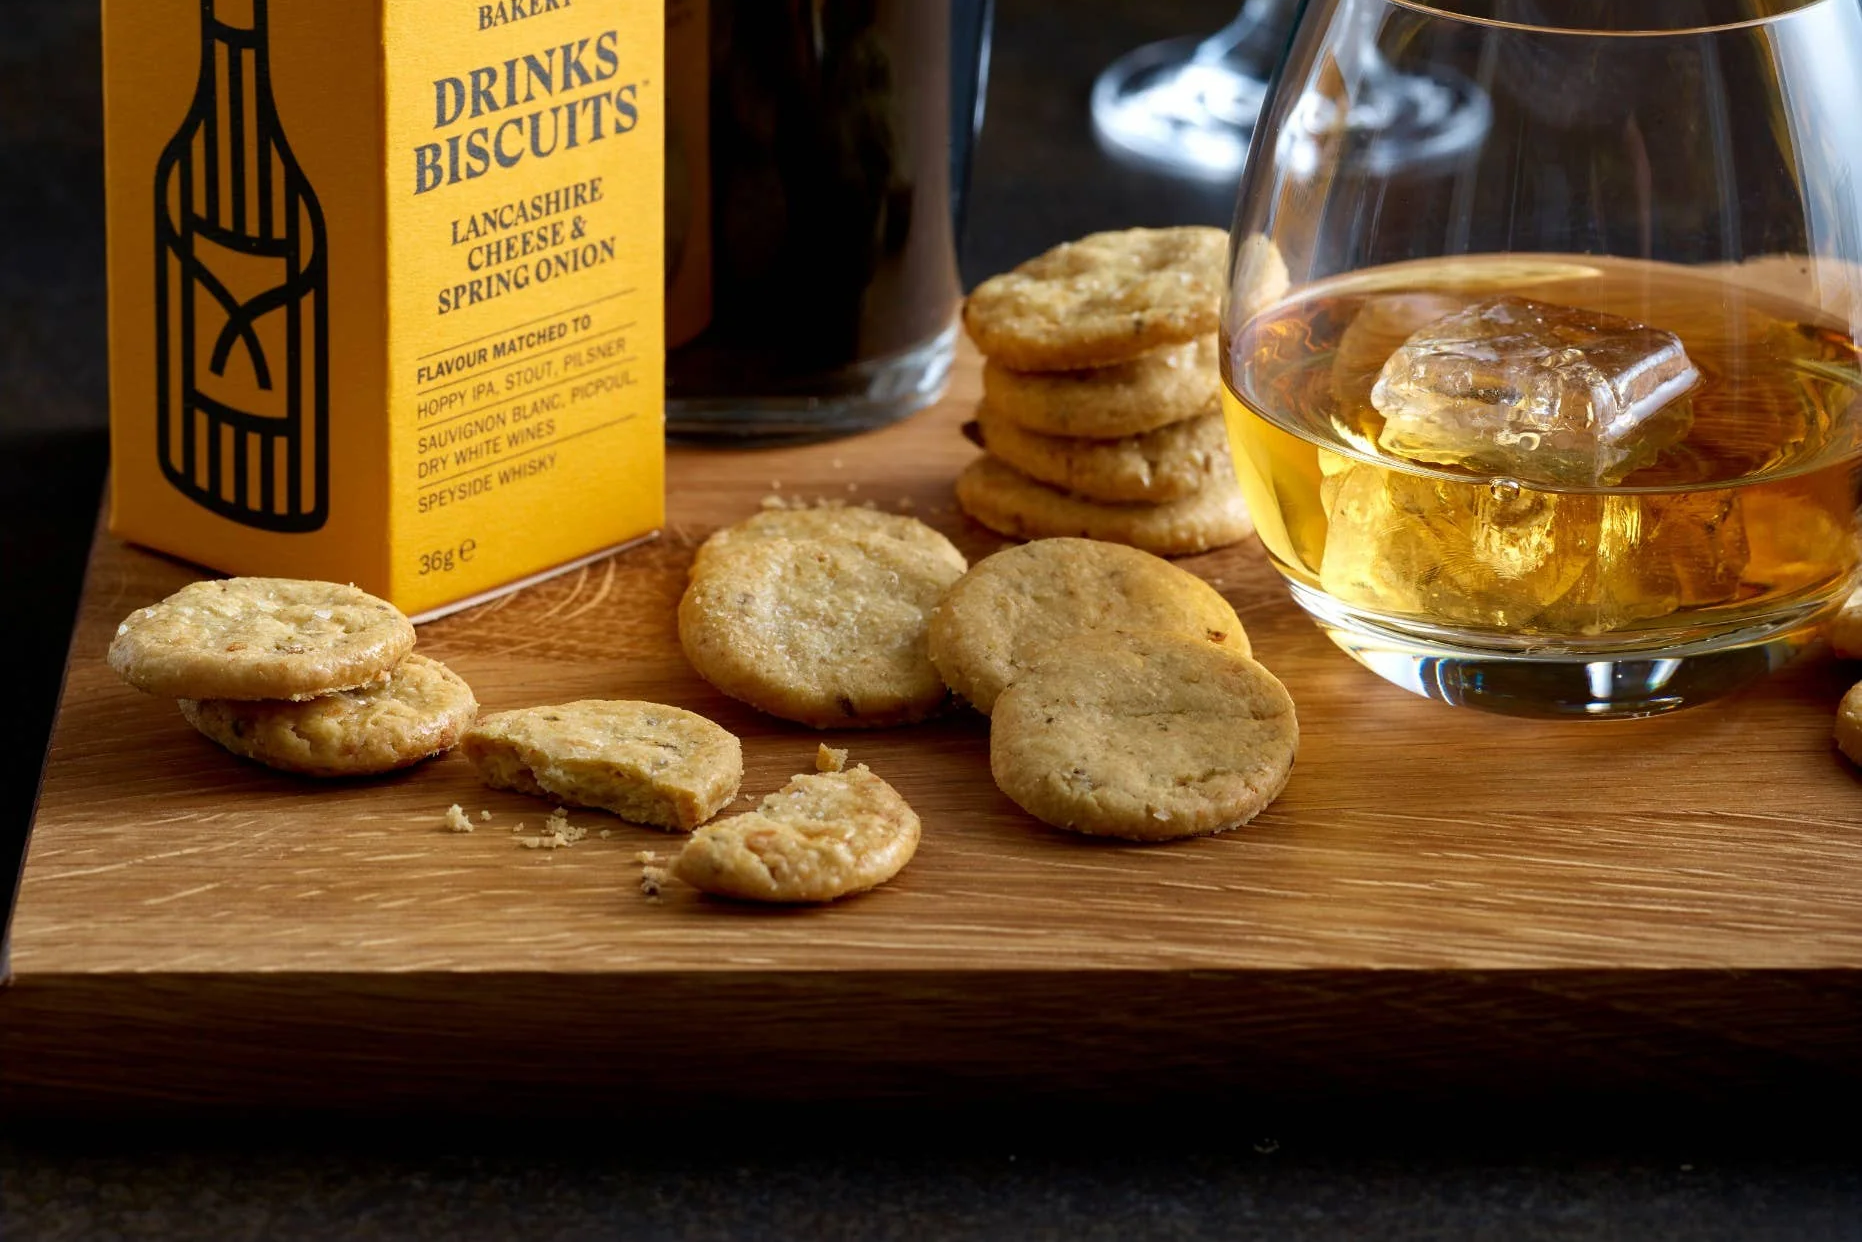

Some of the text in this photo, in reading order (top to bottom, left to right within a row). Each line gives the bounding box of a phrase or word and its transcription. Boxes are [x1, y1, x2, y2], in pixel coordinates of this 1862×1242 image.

[432, 30, 619, 130] DRINKS
[450, 177, 604, 246] LANCASHIRE
[467, 215, 587, 271] CHEESE &
[438, 236, 616, 315] SPRING ONION
[417, 314, 592, 385] FLAVOUR MATCHED TO
[417, 337, 626, 420] HOPPY IPA, STOUT, PILSNER
[417, 412, 507, 455] SAUVIGNON
[512, 394, 566, 424] BLANC,
[417, 419, 556, 479] DRY WHITE WINES
[418, 451, 557, 514] SPEYSIDE WHISKY
[418, 548, 455, 576] 36g
